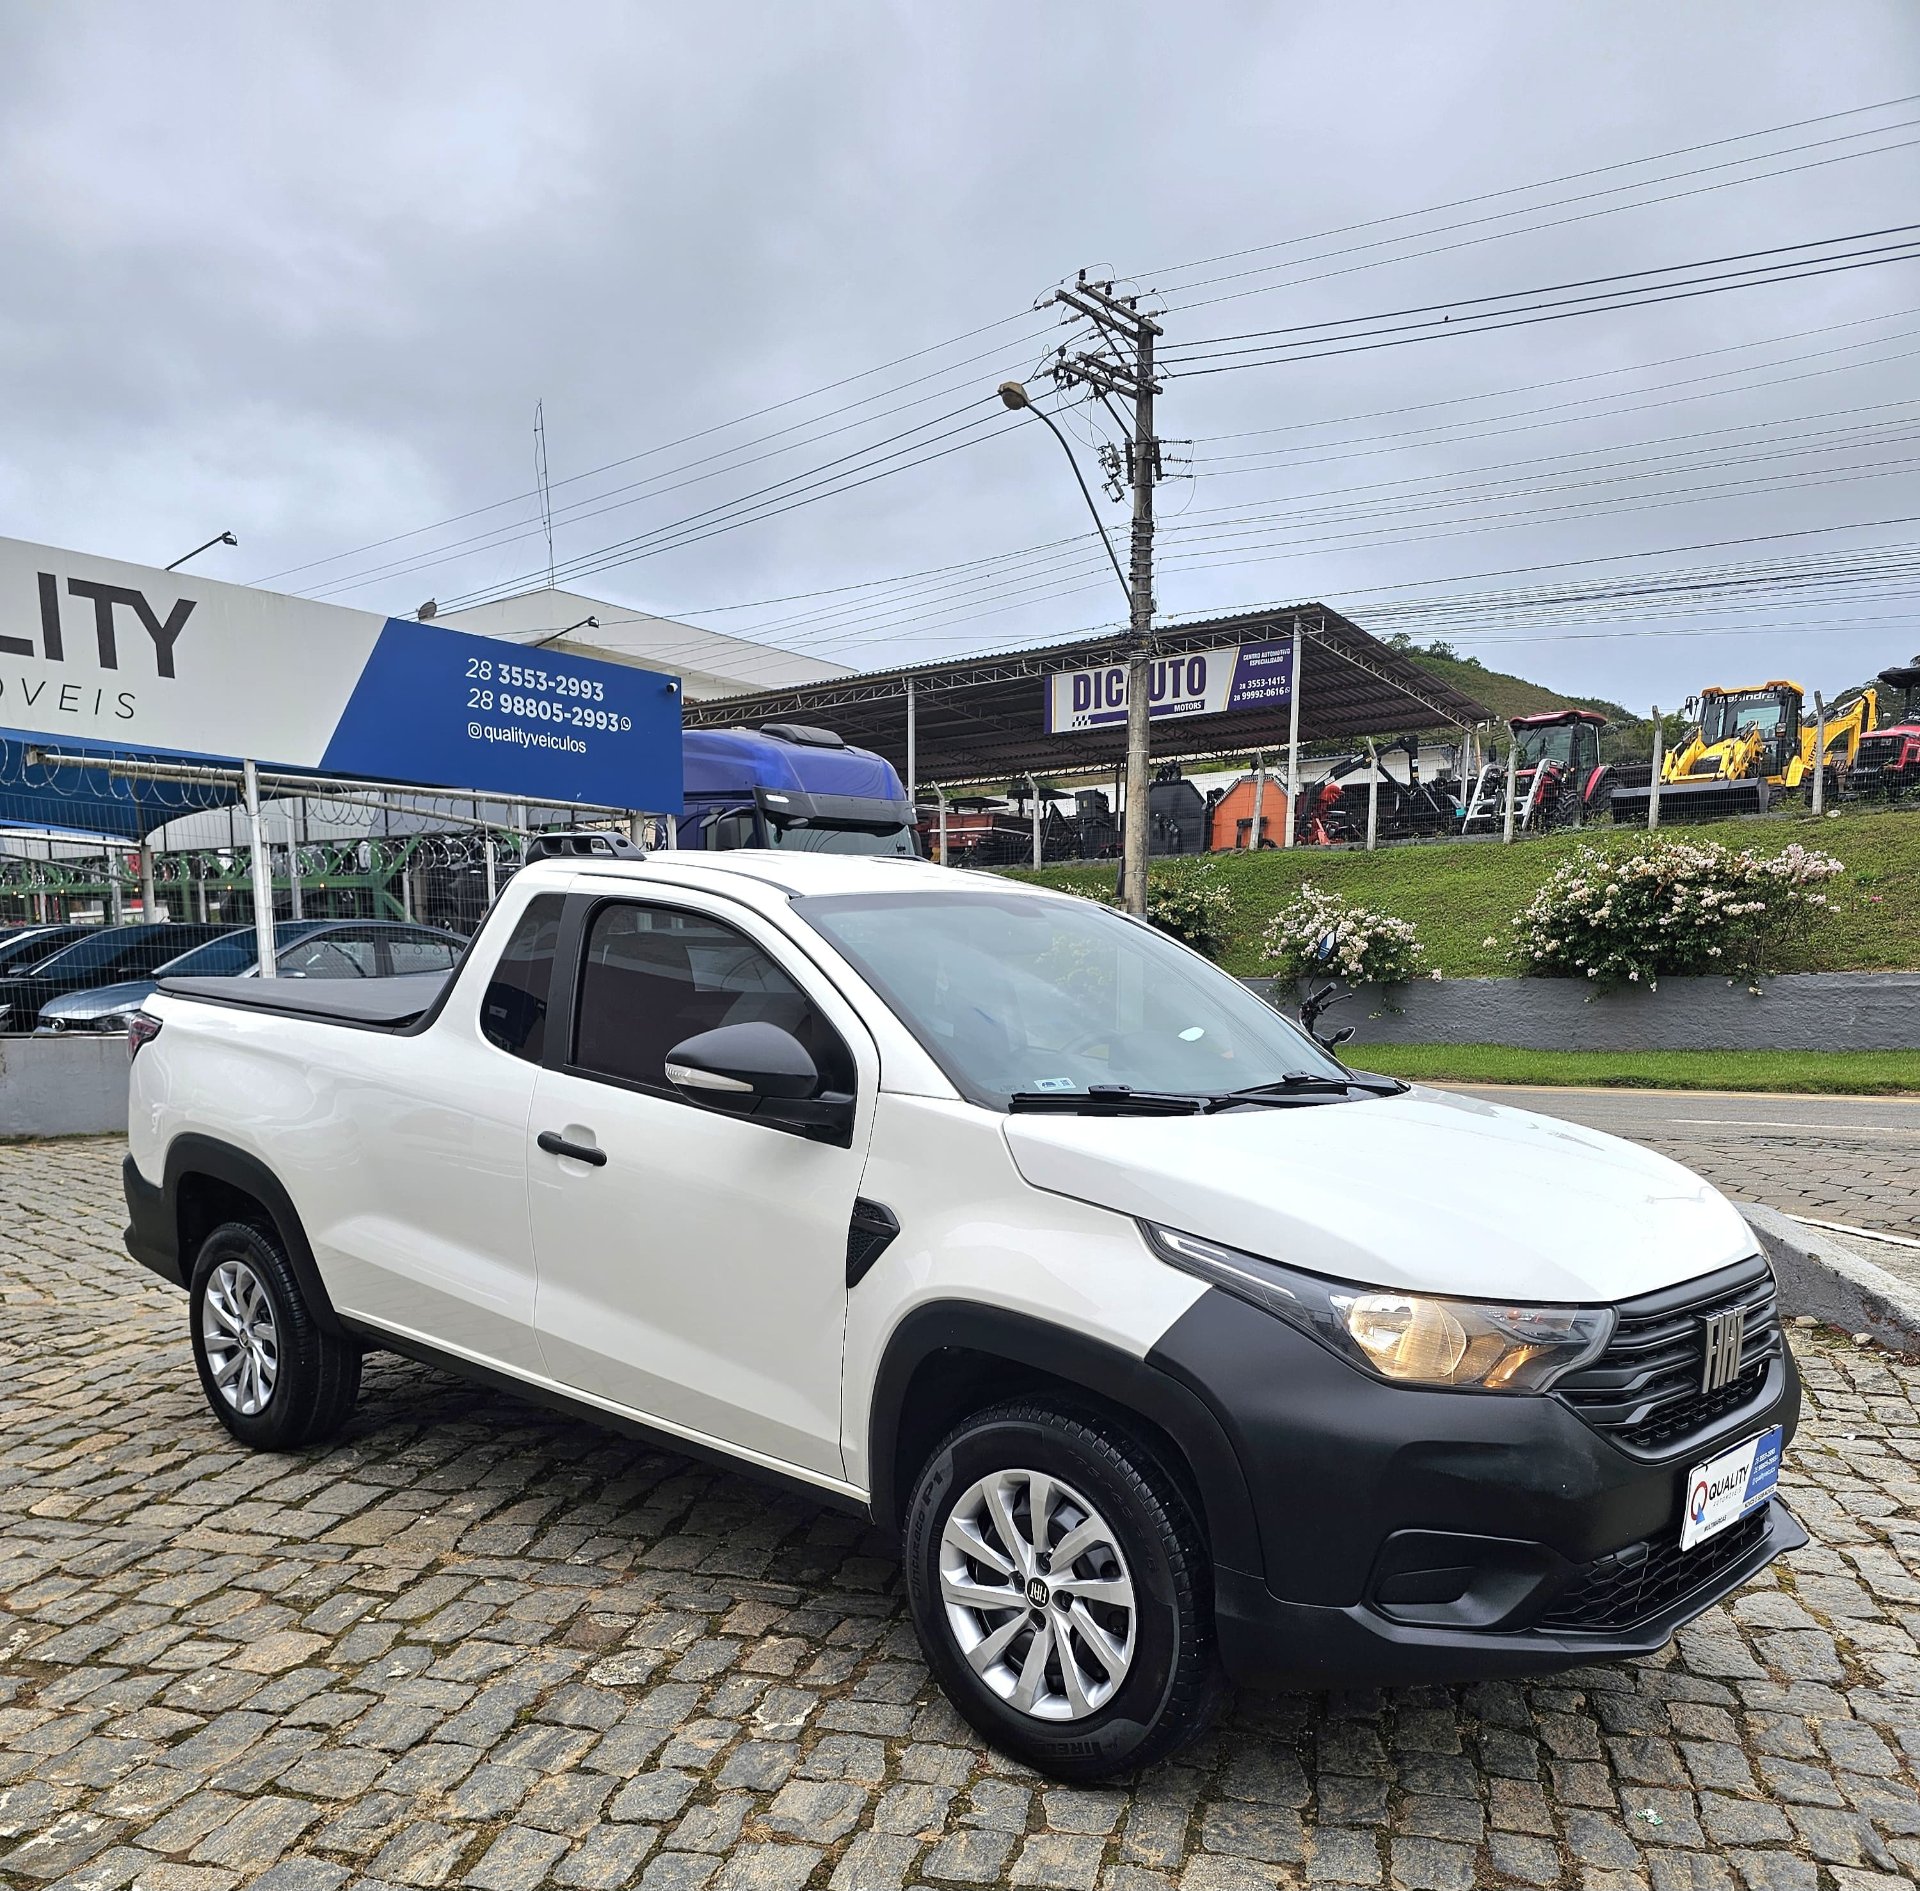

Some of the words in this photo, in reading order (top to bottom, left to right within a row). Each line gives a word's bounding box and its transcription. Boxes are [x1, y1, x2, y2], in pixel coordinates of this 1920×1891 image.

[1249, 656, 1284, 666] ESPECIALIZADO
[1261, 648, 1291, 658] AUTOMOTIVO
[465, 657, 493, 681] 28
[498, 663, 605, 702] 3553-2993
[1073, 656, 1207, 712] DICUTO
[1241, 687, 1285, 700] 99992-0616
[1247, 676, 1286, 689] 3553-1415
[0, 676, 136, 719] VEIS
[466, 687, 495, 710] 28
[499, 693, 619, 732] 98805-2993
[1174, 702, 1202, 713] MOTORS
[484, 725, 587, 753] qualityveiculos
[1702, 1305, 1748, 1394] FIAT
[921, 1471, 944, 1507] P1
[1708, 1464, 1750, 1501] QUALITY
[1029, 1581, 1047, 1604] FIAT
